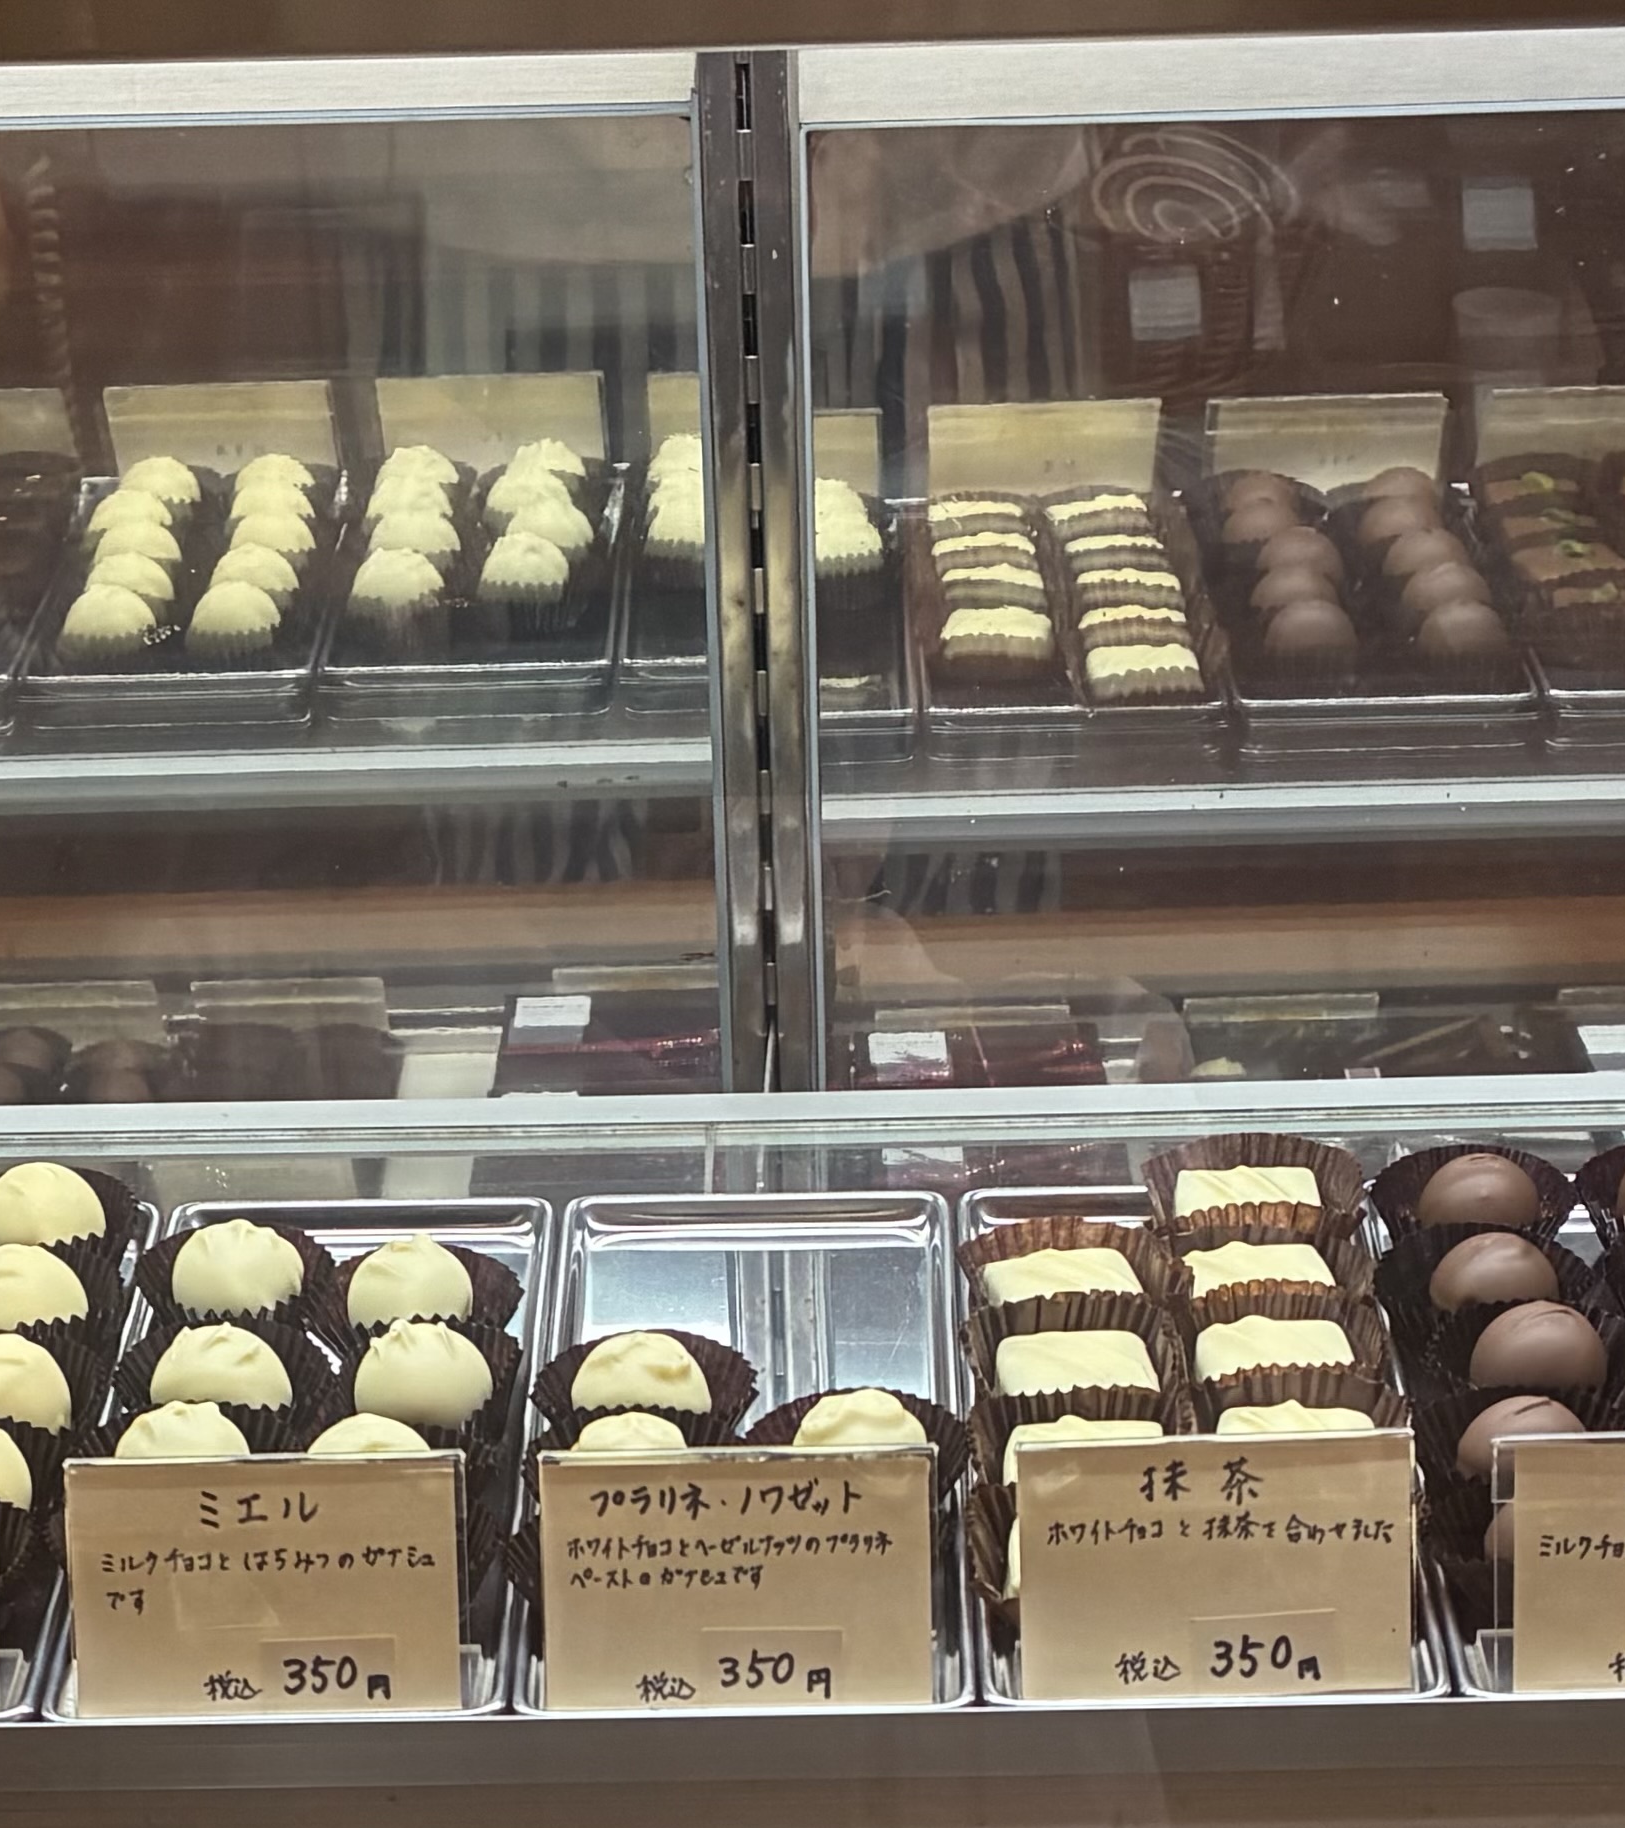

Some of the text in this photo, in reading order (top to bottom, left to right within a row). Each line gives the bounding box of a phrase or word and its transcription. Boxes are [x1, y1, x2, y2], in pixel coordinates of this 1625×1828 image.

[1139, 1456, 1262, 1506] 抹茶
[199, 1490, 318, 1529] ミエル
[106, 1589, 144, 1615] です
[203, 1655, 391, 1701] 税込 350円
[635, 1648, 832, 1703] 税込 350円
[1114, 1634, 1321, 1685] 税込 350円
